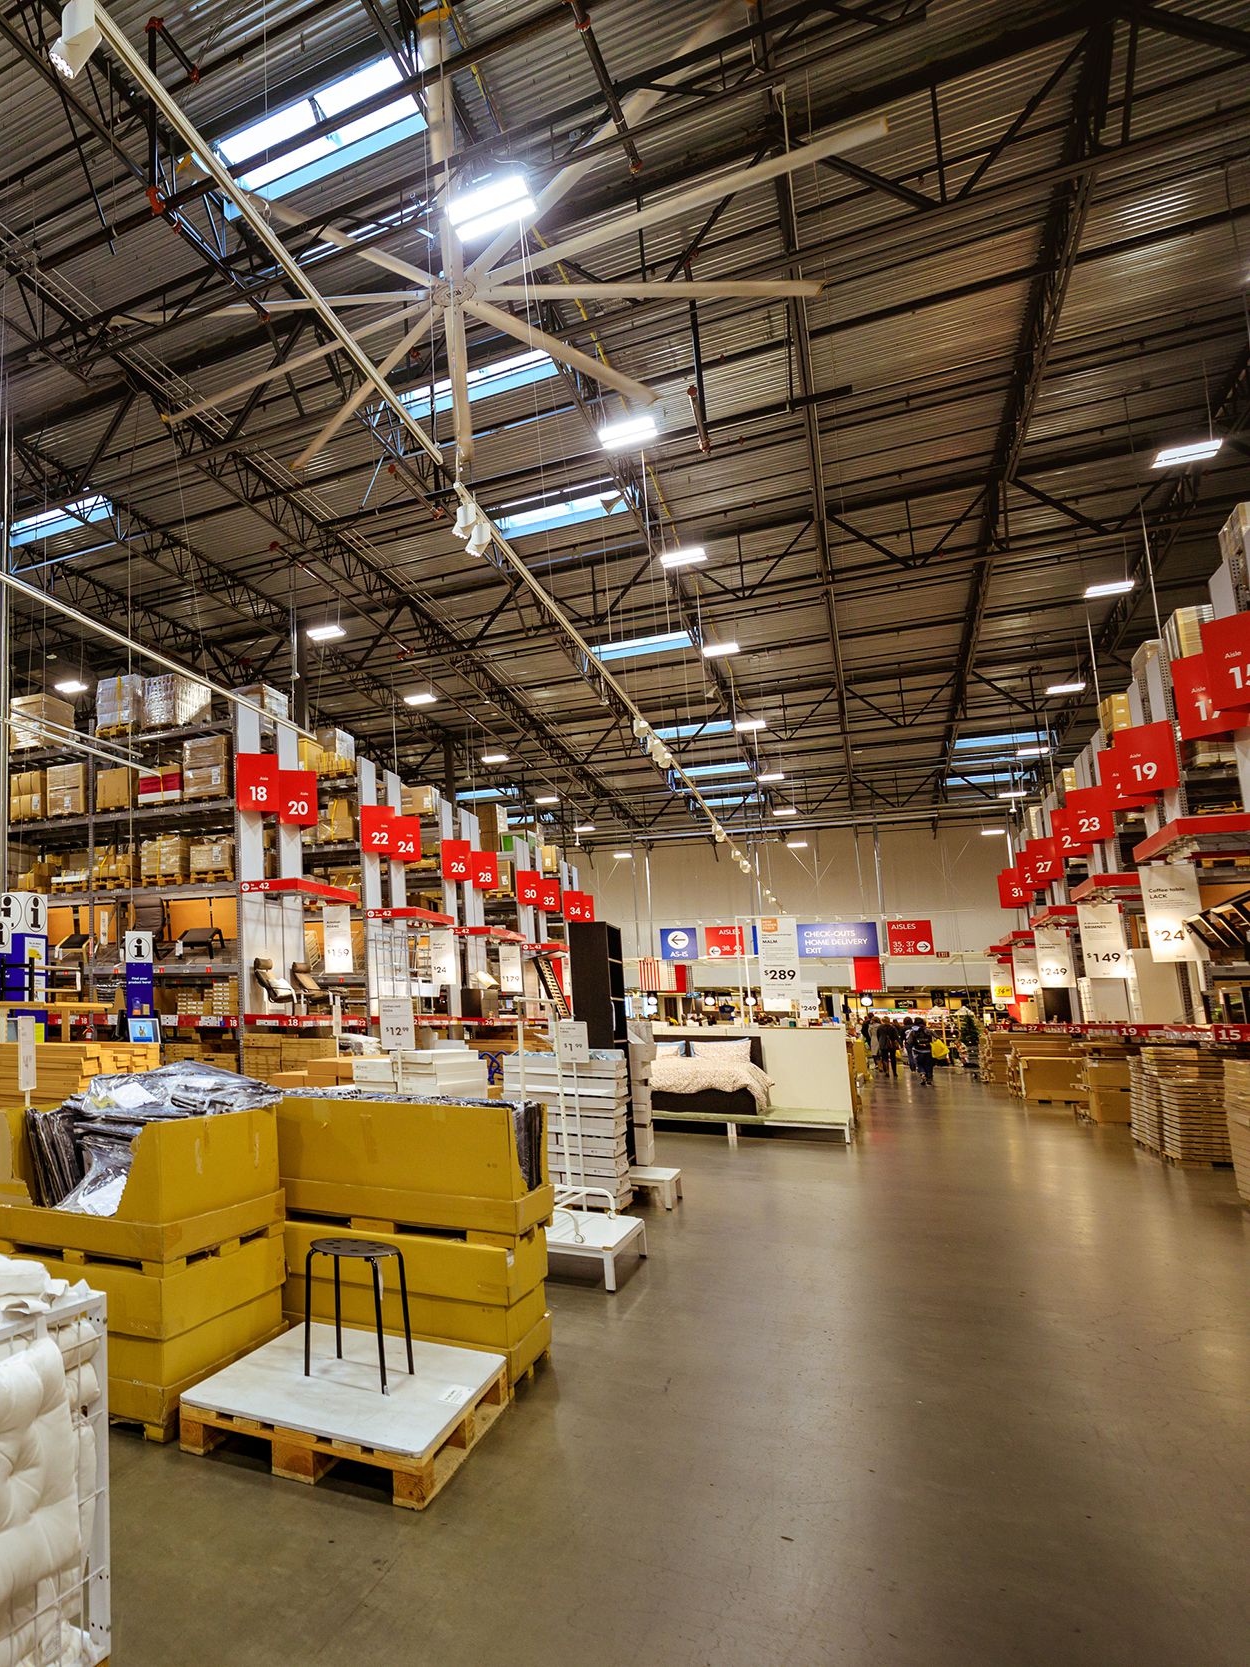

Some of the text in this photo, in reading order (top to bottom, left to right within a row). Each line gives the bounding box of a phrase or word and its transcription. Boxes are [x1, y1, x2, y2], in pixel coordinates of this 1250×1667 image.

[1225, 651, 1242, 659] Aisle
[1132, 762, 1157, 781] 19
[250, 786, 267, 801] 18
[288, 800, 308, 815] 20
[1079, 817, 1100, 832] 23
[372, 832, 389, 845] 22
[1062, 836, 1081, 848] 2
[398, 841, 414, 853] 24
[451, 862, 466, 873] 26
[1036, 861, 1052, 873] 27
[478, 872, 492, 882] 28
[524, 889, 536, 898] 30
[1012, 887, 1023, 897] 31
[543, 897, 554, 905] 32
[570, 906, 581, 915] 34
[1087, 953, 1121, 962] $149
[764, 970, 796, 980] $289
[1218, 1030, 1241, 1040] 15
